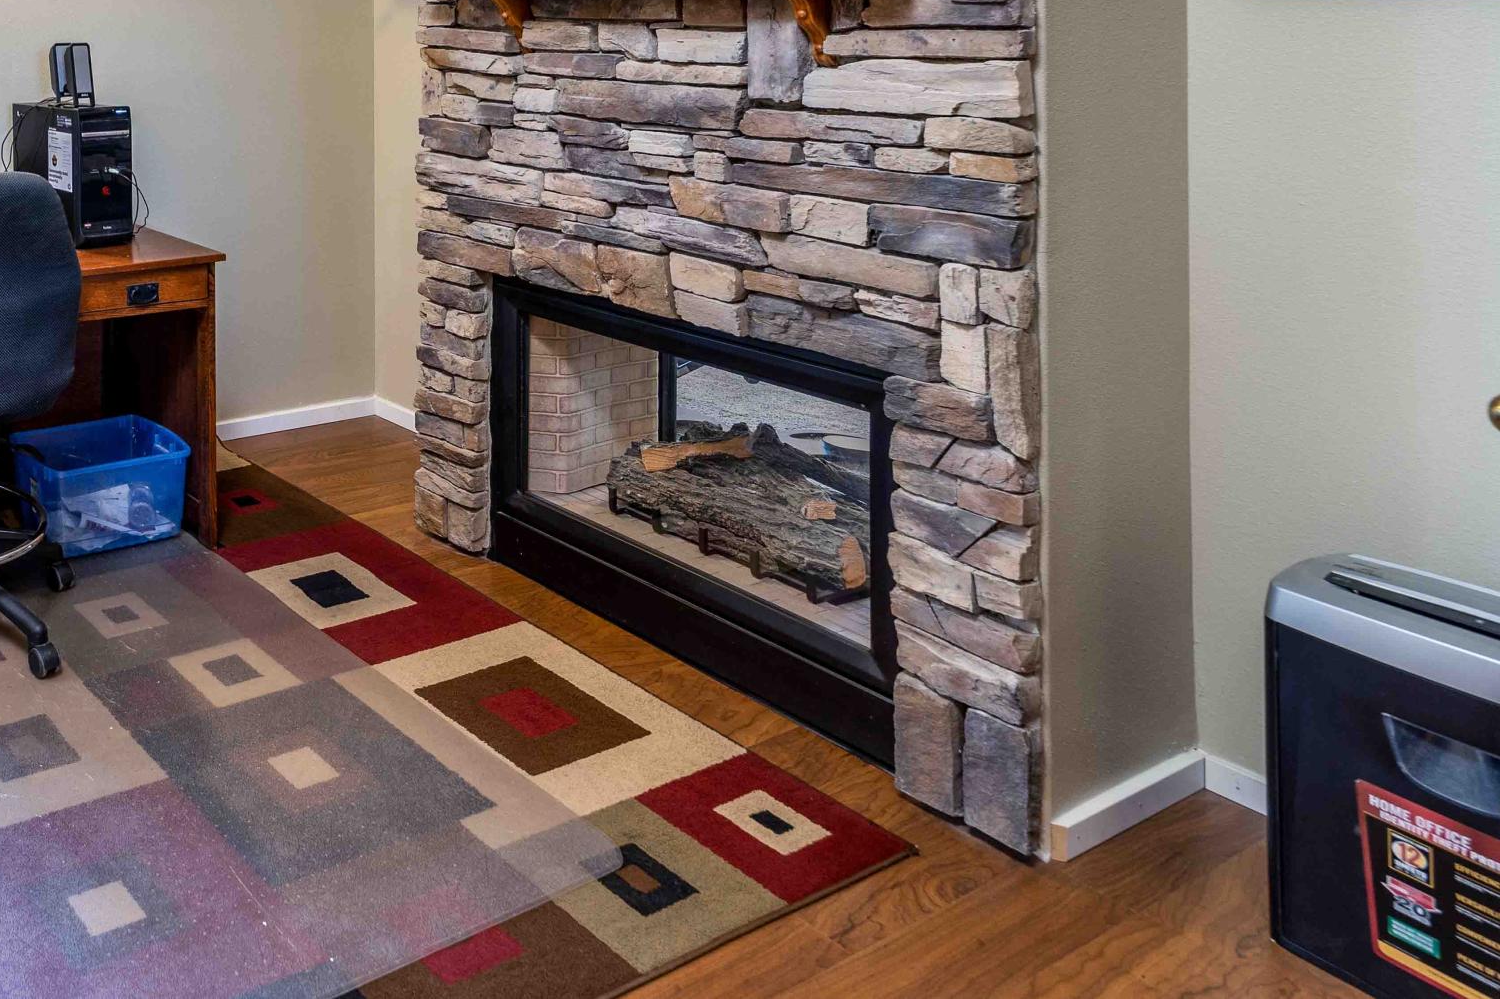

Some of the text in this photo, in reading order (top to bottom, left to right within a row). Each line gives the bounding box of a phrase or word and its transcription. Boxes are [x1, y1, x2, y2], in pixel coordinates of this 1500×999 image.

[1368, 793, 1412, 821] HOME
[1415, 815, 1472, 850] OFFICE
[1379, 810, 1429, 841] IDENTITY
[1398, 842, 1420, 864] 12
